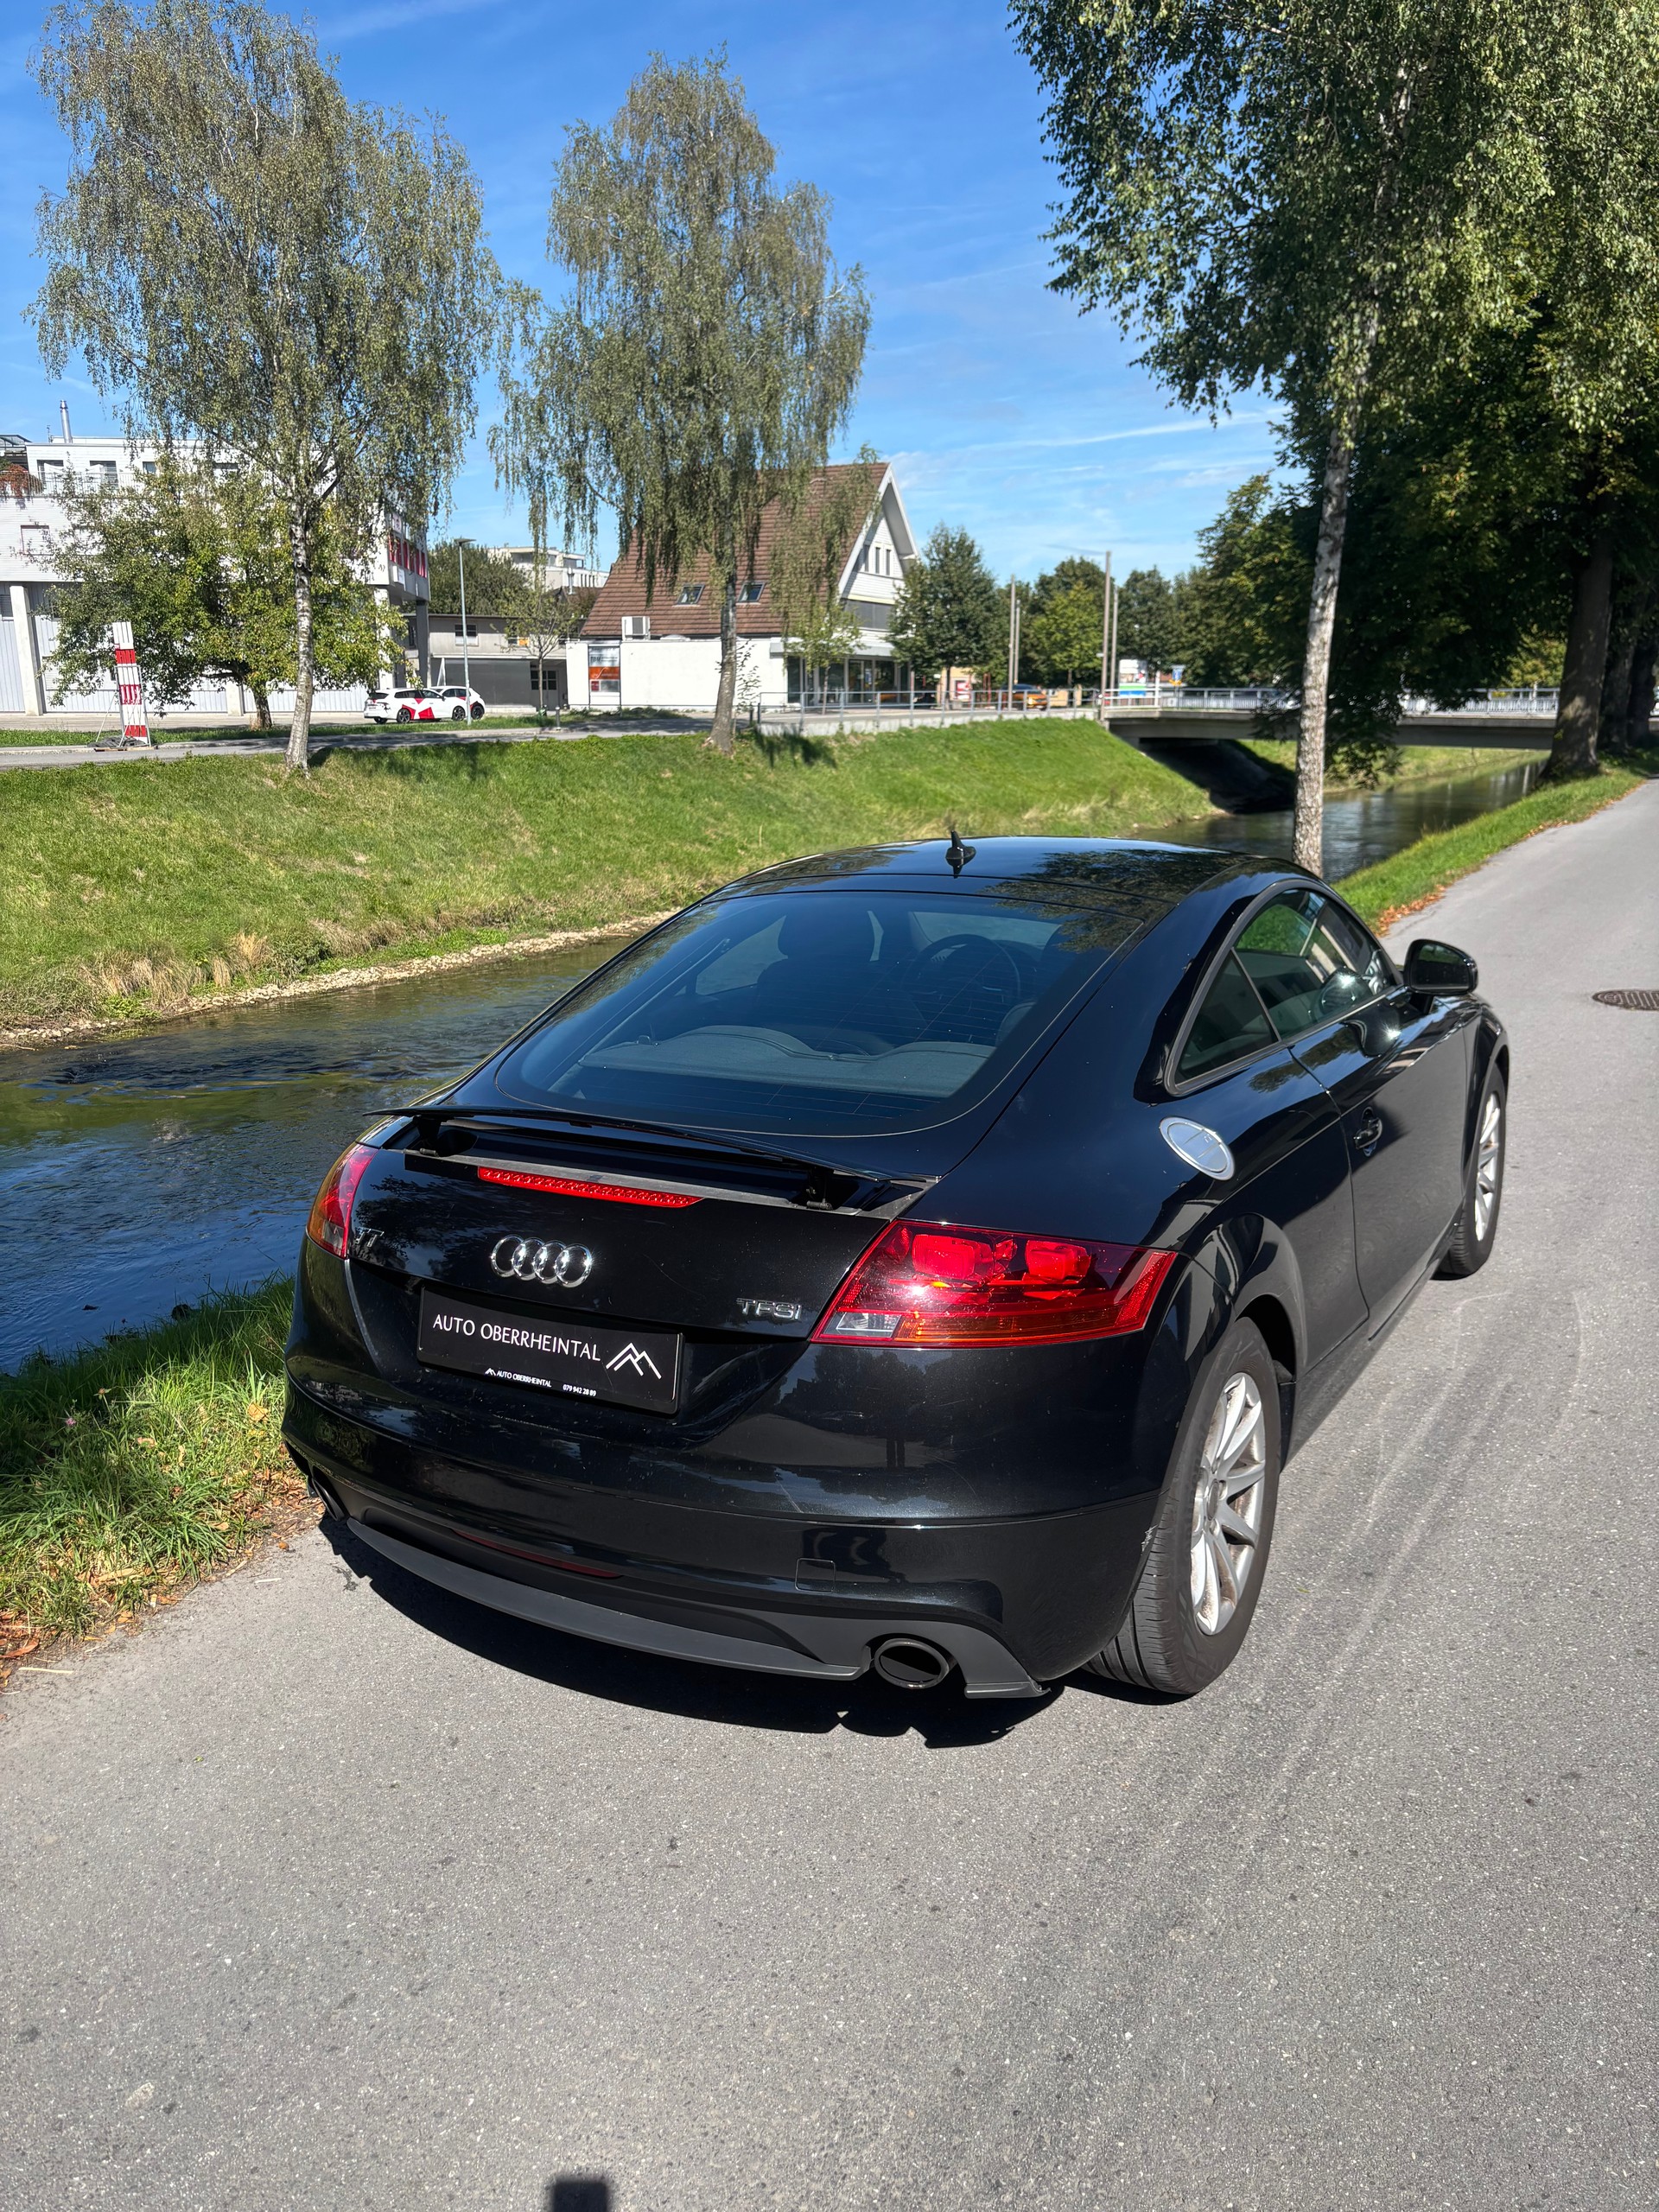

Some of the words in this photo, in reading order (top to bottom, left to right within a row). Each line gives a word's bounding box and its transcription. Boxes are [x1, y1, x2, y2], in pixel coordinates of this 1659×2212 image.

[353, 1226, 385, 1247] TT
[736, 1298, 802, 1320] TFSI
[433, 1314, 475, 1336] AUTO
[480, 1323, 601, 1362] OBERRHEINTAL
[497, 1370, 512, 1379] AUTO
[513, 1374, 551, 1388] OBERRHEINTAL
